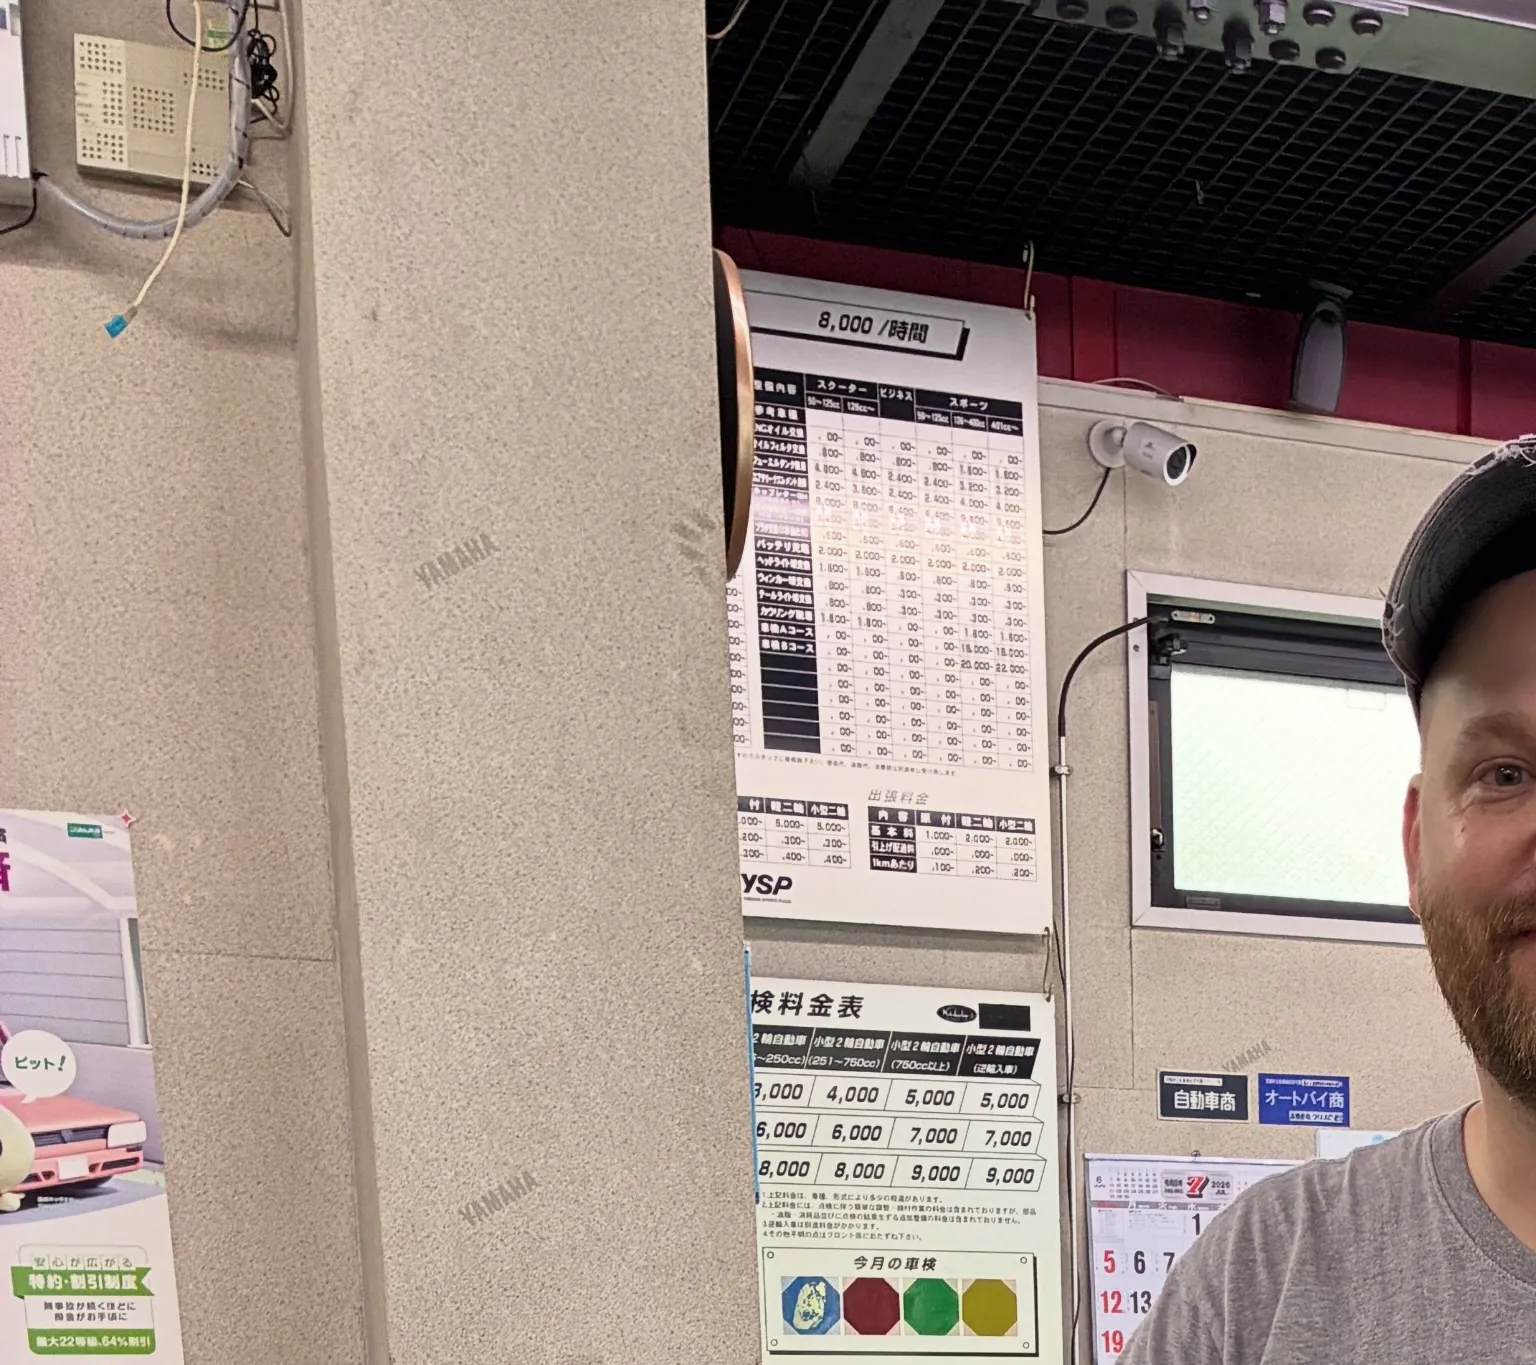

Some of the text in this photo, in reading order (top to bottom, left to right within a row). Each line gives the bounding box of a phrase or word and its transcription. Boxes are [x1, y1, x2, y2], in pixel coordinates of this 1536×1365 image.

[818, 311, 929, 344] 8,000 /時間
[817, 379, 867, 393] スクーター
[880, 387, 913, 401] ビジネス
[949, 397, 988, 411] スポーツ
[413, 531, 500, 590] YAMAHA
[868, 789, 929, 806] 出張料金
[741, 873, 793, 896] YSP
[751, 990, 864, 1019] 検料金表
[826, 1084, 879, 1105] 4,000
[904, 1088, 955, 1108] 5,000
[980, 1091, 1029, 1111] 5,000
[1174, 1090, 1236, 1112] 自動車商
[1265, 1090, 1344, 1109] オートバイ商
[756, 1121, 1032, 1148] 6,000 6,000 7,000 7,000
[758, 1159, 1035, 1186] 8,000 8,000 9,000 9,000
[457, 1170, 539, 1229] YAMAHA
[854, 1256, 937, 1272] 今月の車検
[1103, 1251, 1175, 1274] 5 6 7
[1100, 1291, 1152, 1314] 12 13
[1101, 1330, 1124, 1353] 19
